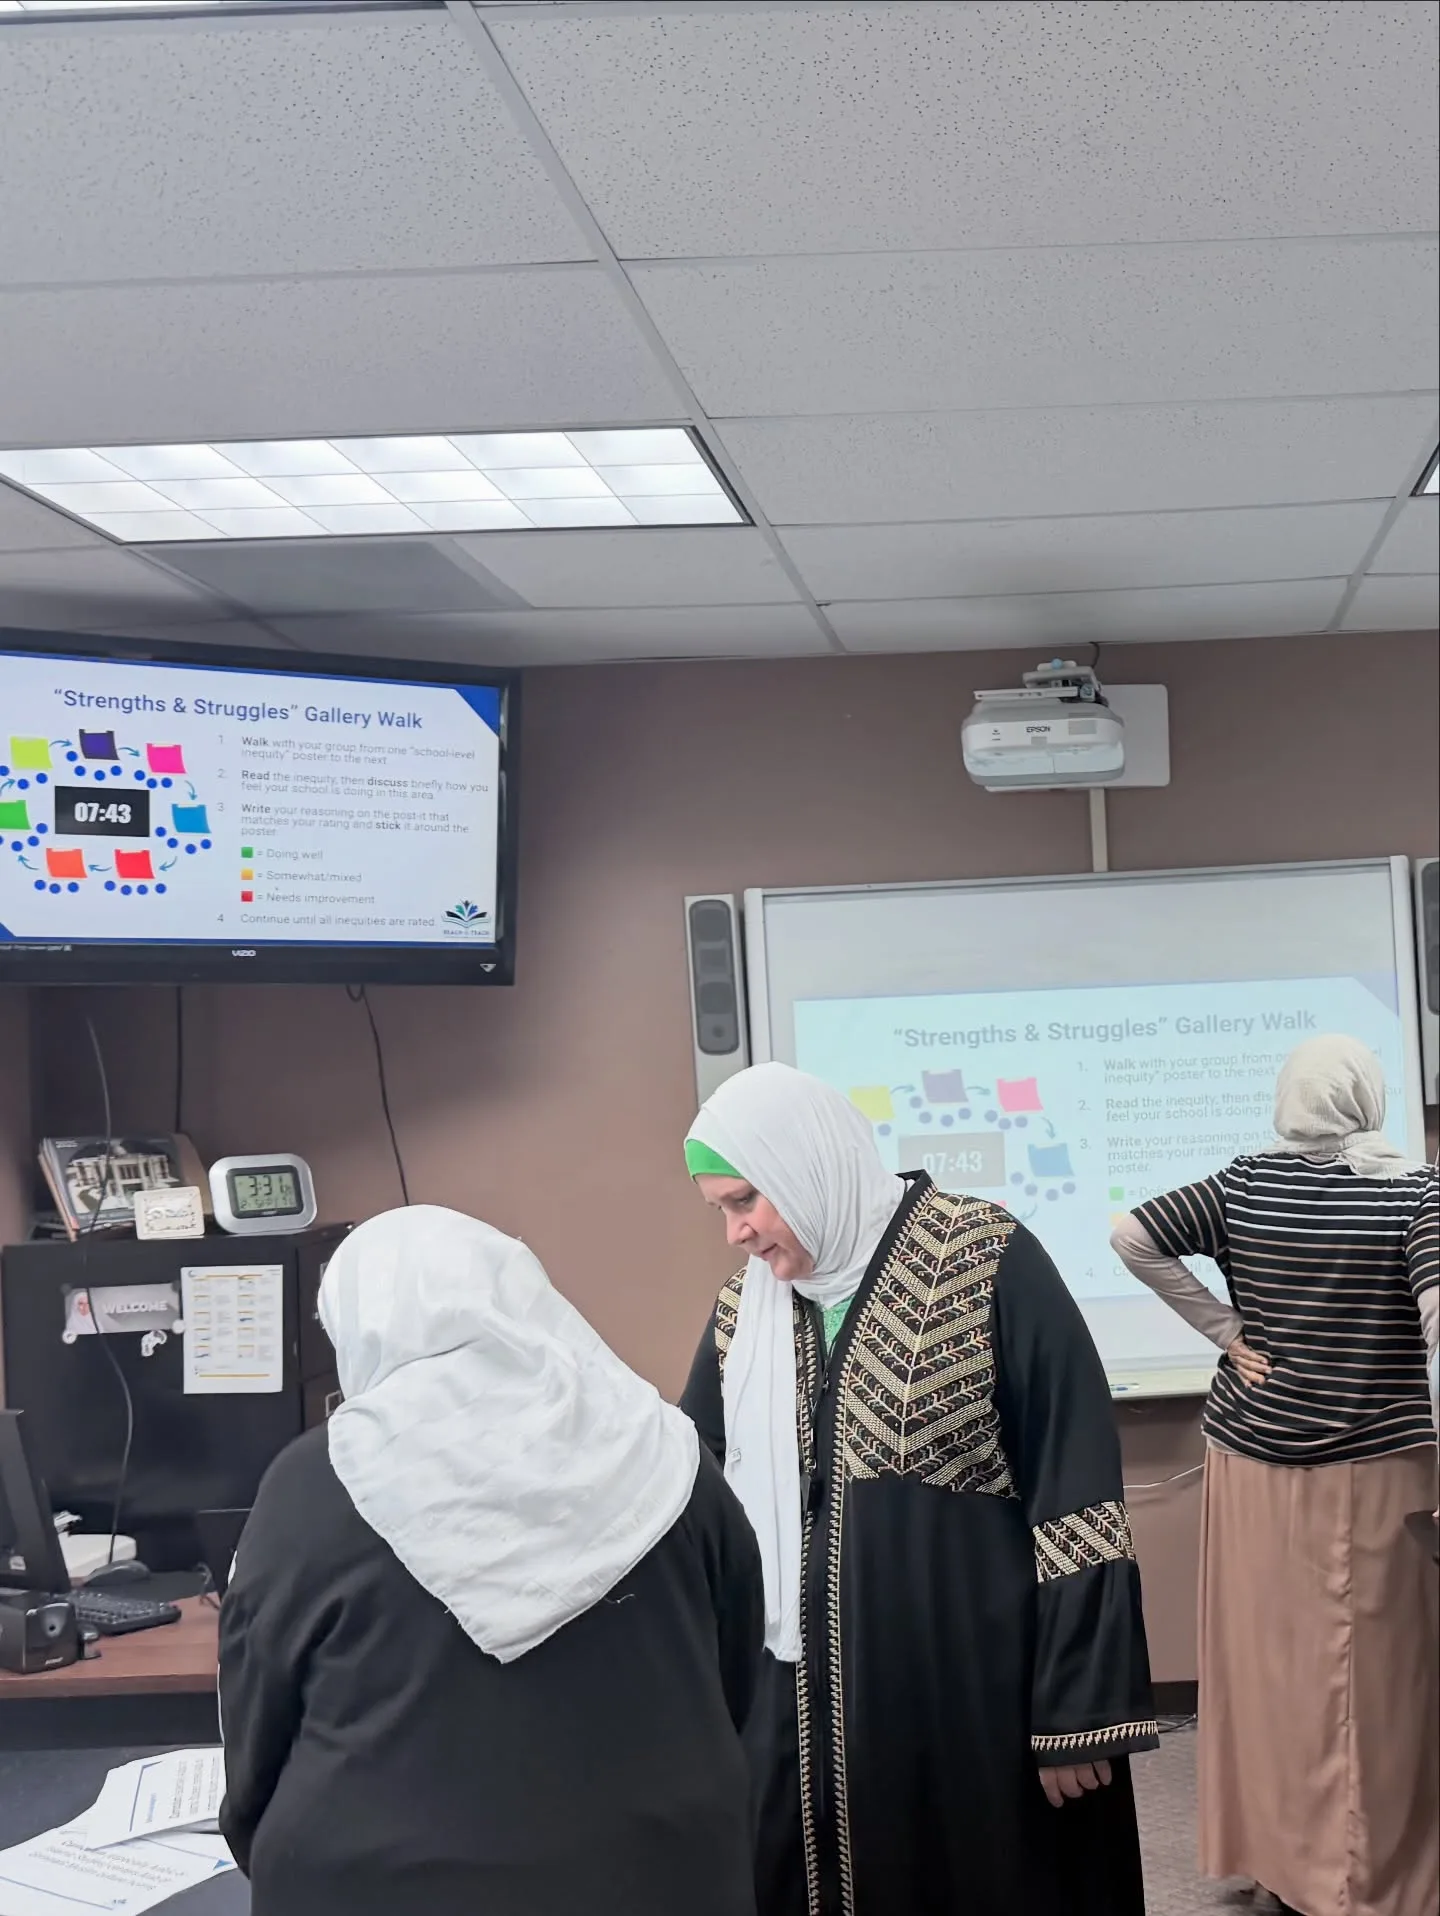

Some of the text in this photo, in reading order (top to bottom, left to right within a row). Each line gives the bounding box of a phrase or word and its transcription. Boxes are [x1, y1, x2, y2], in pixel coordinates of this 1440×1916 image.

[173, 698, 187, 713] &
[305, 706, 372, 728] Gallery
[378, 711, 422, 729] Walk
[1026, 725, 1051, 733] EPSON
[241, 736, 269, 747] Walk
[272, 739, 295, 748] with
[298, 741, 321, 751] your
[325, 742, 356, 753] group
[360, 744, 385, 753] from
[388, 746, 407, 755] one
[292, 752, 327, 761] poster
[330, 753, 341, 761] to
[344, 754, 361, 763] the
[241, 770, 270, 780] Read
[273, 772, 290, 781] the
[341, 775, 364, 784] then
[367, 777, 408, 787] discuss
[411, 779, 442, 791] briefly
[445, 781, 467, 791] how
[470, 784, 489, 793] you
[241, 781, 261, 791] feel
[264, 784, 288, 794] your
[292, 784, 328, 794] school
[331, 786, 341, 795] is
[344, 787, 373, 798] doing
[376, 788, 386, 797] in
[388, 789, 408, 798] this
[74, 801, 132, 824] 07:43
[241, 803, 271, 814] Write
[274, 806, 298, 816] your
[300, 807, 355, 819] reasoning
[357, 810, 370, 818] on
[373, 810, 391, 819] the
[429, 812, 449, 821] that
[241, 815, 469, 833] matches your rating and stick it around the
[266, 848, 299, 861] Doing
[301, 850, 323, 860] well
[266, 870, 362, 882] Somewhat/mixed
[266, 892, 301, 903] Needs
[304, 894, 375, 905] improvement
[240, 913, 290, 924] Continue
[292, 914, 316, 924] until
[319, 915, 331, 925] all
[335, 915, 386, 927] inequities
[388, 918, 405, 926] are
[1024, 1022, 1040, 1042] &
[1175, 1014, 1255, 1037] Gallery
[1261, 1009, 1318, 1031] Walk
[1103, 1058, 1136, 1071] Walk
[1139, 1057, 1166, 1069] with
[1169, 1056, 1198, 1070] your
[1201, 1055, 1238, 1068] group
[1242, 1052, 1272, 1065] from
[1163, 1069, 1202, 1083] poster
[1208, 1068, 1220, 1079] to
[1224, 1066, 1246, 1078] the
[1105, 1098, 1138, 1110] Read
[1142, 1096, 1163, 1108] the
[1221, 1092, 1250, 1104] then
[1106, 1110, 1130, 1122] feel
[1133, 1110, 1160, 1124] your
[1165, 1107, 1208, 1119] school
[1211, 1106, 1222, 1117] is
[1225, 1104, 1263, 1119] doing
[1107, 1136, 1142, 1148] Write
[1144, 1135, 1173, 1148] your
[1176, 1131, 1240, 1147] reasoning
[1243, 1130, 1260, 1142] on
[1107, 1148, 1163, 1161] matches
[1167, 1146, 1194, 1160] your
[1198, 1143, 1235, 1157] rating
[922, 1150, 983, 1173] 07:43
[103, 1300, 169, 1314] WELCOME
